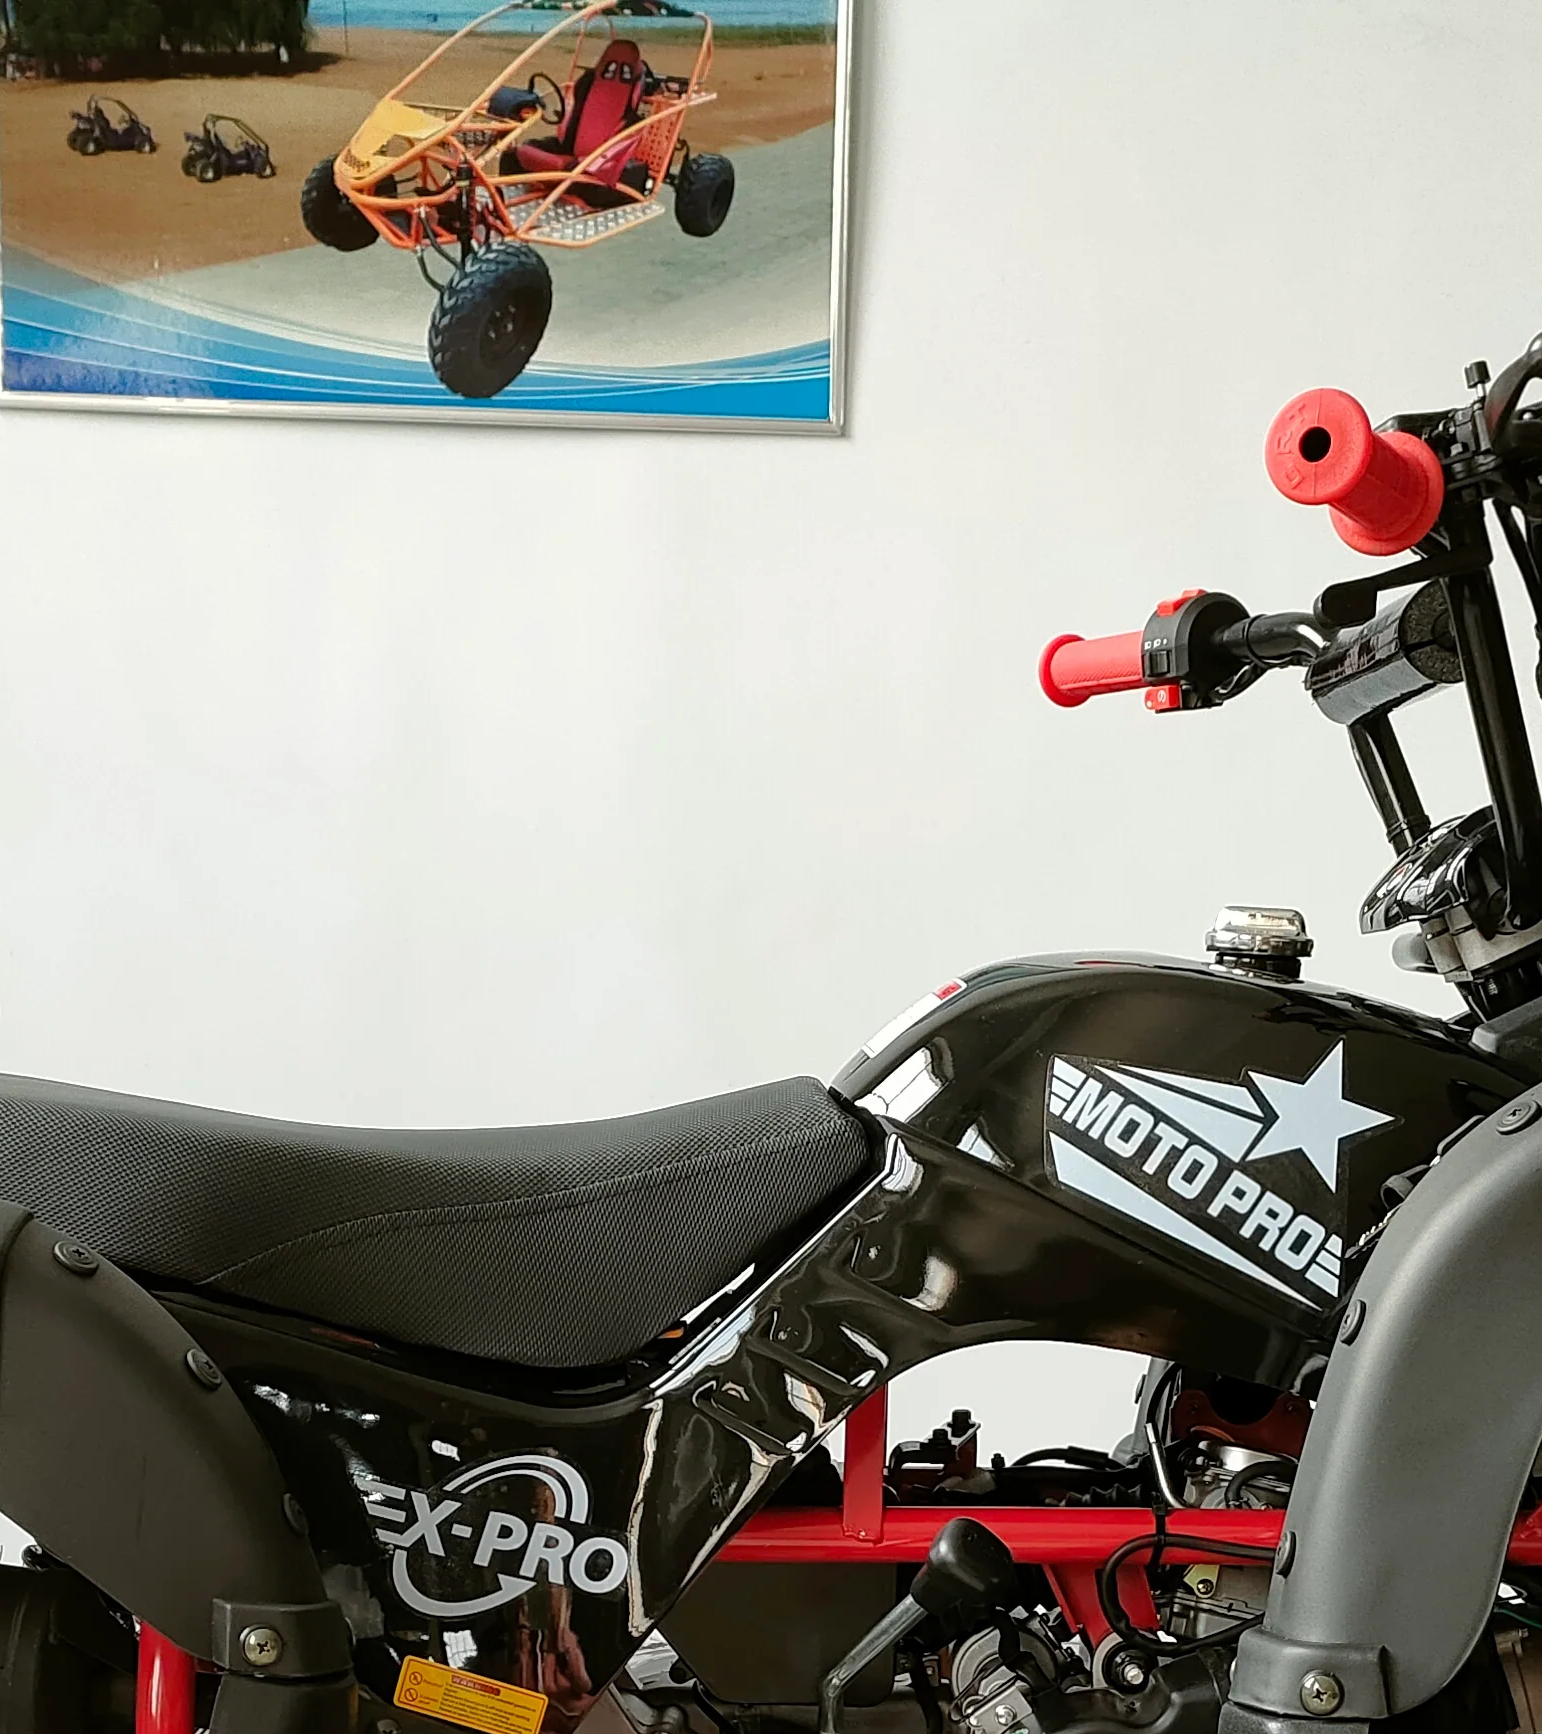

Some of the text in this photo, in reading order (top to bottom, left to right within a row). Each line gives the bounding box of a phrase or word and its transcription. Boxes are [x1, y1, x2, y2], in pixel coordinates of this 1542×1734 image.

[1061, 1073, 1327, 1272] MOTO PRO
[361, 1480, 629, 1594] EX-PRO
